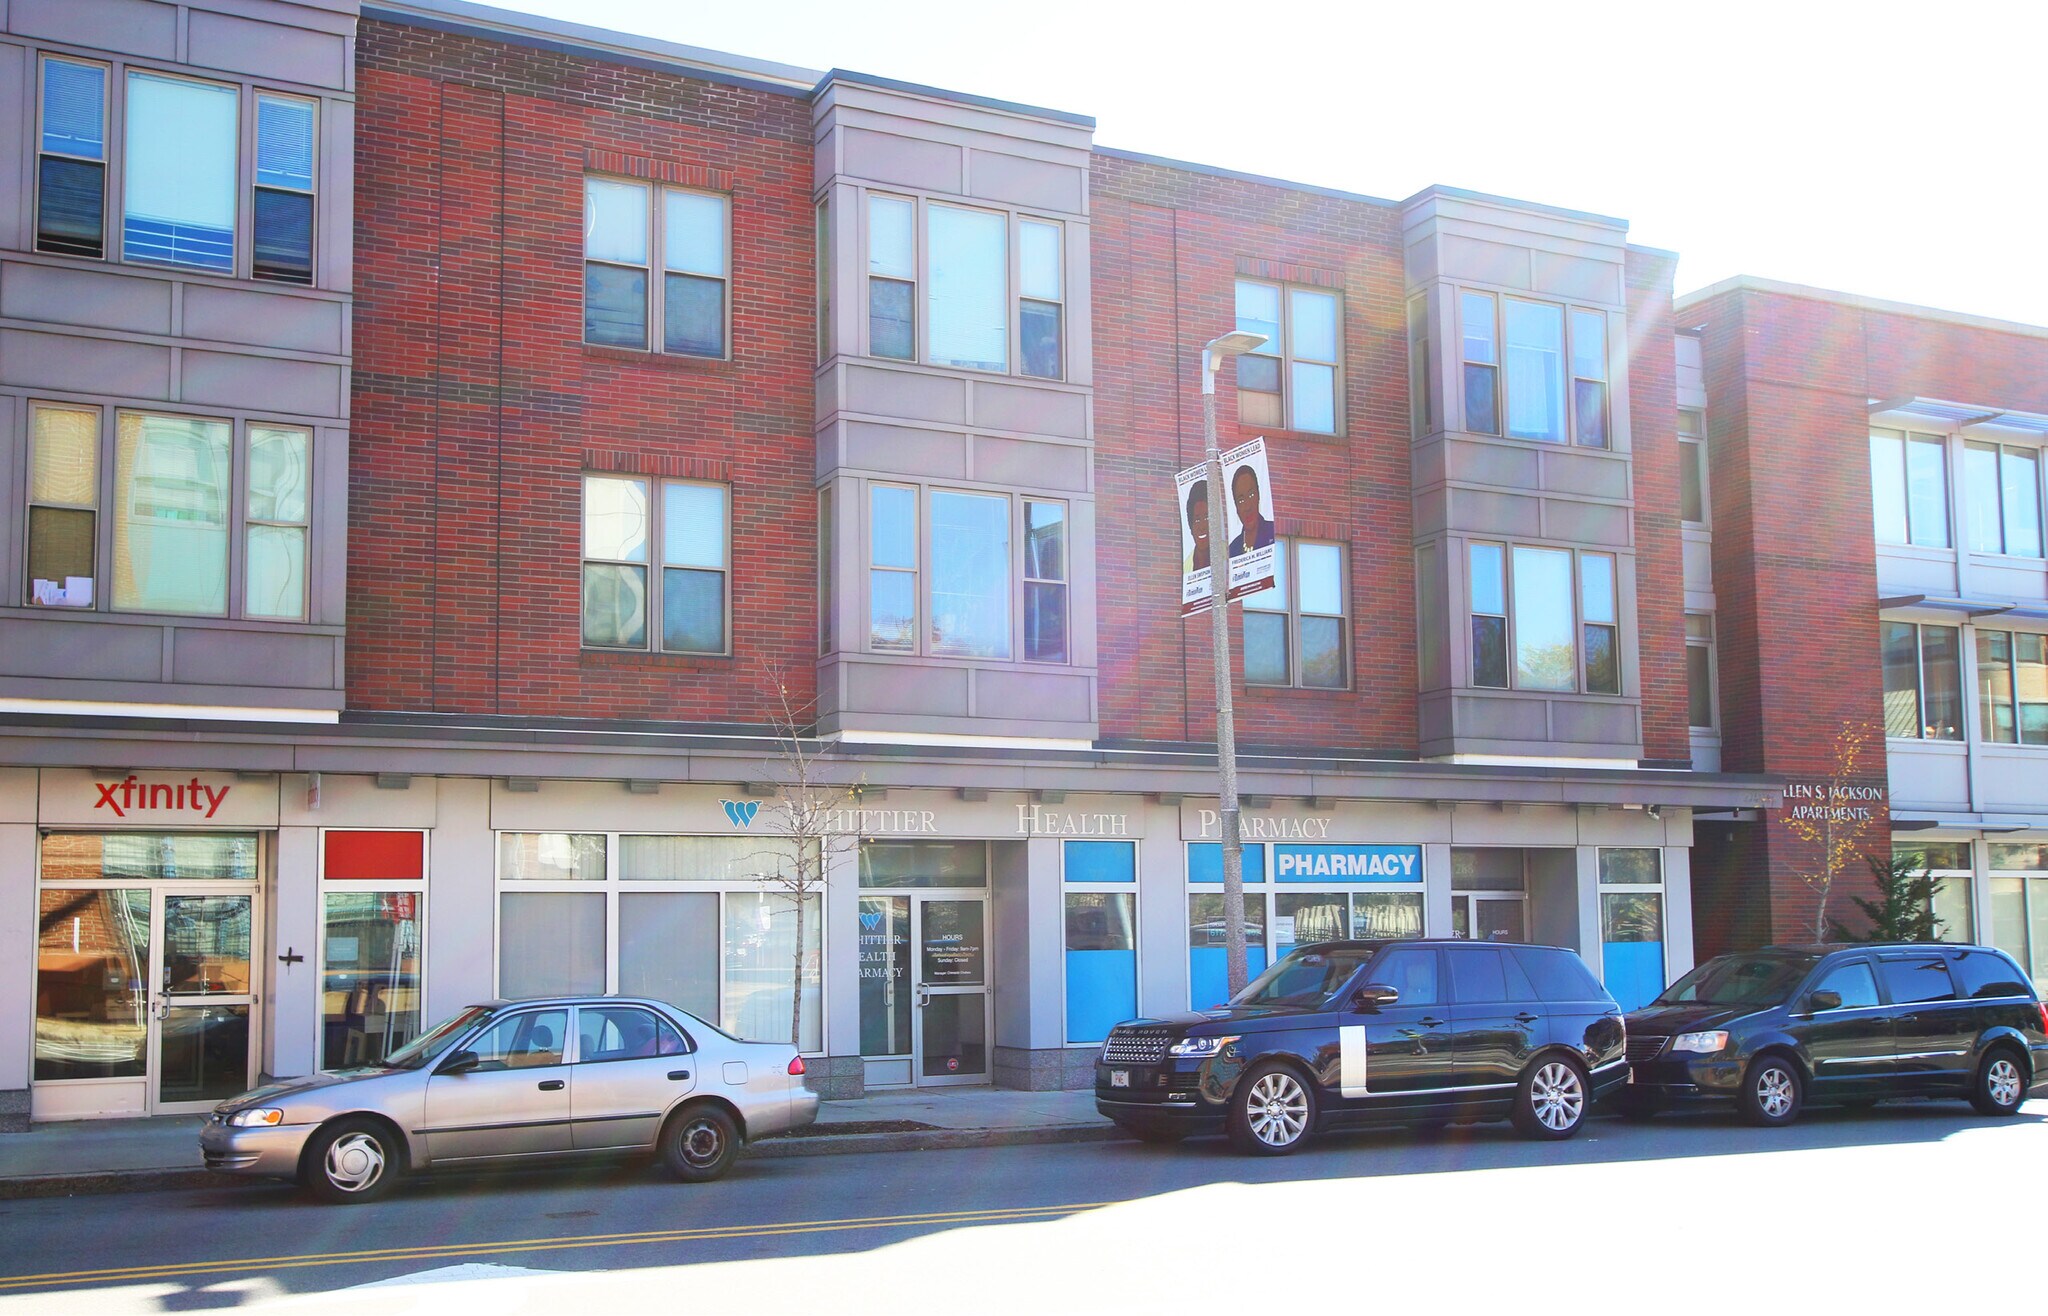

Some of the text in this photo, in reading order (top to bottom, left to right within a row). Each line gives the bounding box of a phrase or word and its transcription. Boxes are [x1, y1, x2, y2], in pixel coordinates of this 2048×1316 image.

[1236, 447, 1251, 459] WOMEN
[94, 775, 231, 819] xfinity
[1783, 784, 1811, 798] LLEN
[784, 800, 938, 832] WHITTIER
[1016, 804, 1127, 836] HEALTH
[1198, 809, 1331, 838] PARMACY
[1279, 853, 1416, 876] PHARMACY
[859, 934, 902, 945] HITTIER
[942, 933, 963, 941] HOURS
[859, 951, 896, 962] EALTH
[859, 967, 904, 978] ARMACY
